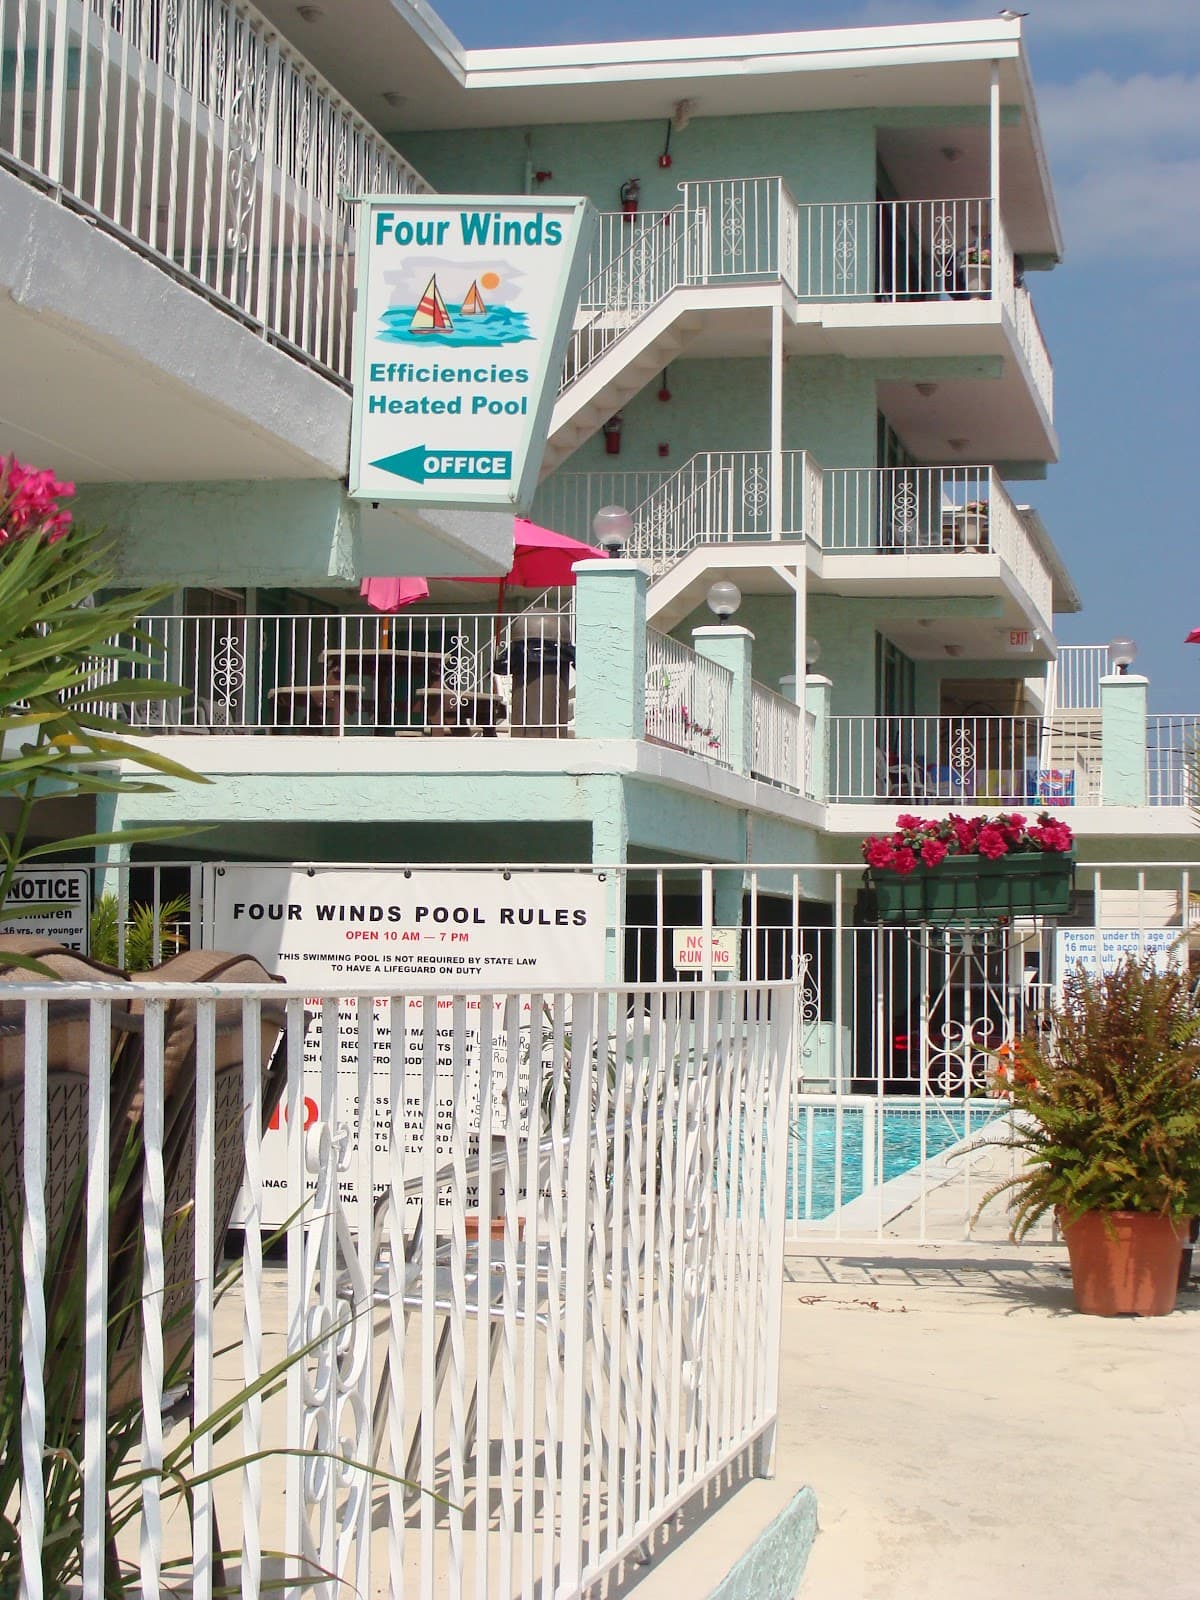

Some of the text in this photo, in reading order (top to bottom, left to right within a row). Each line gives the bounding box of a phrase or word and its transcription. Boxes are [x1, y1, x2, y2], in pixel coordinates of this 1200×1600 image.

[375, 211, 562, 246] Four Winds
[370, 363, 529, 383] Efficiencies
[368, 395, 528, 415] Heated Pool
[423, 455, 507, 474] OFFICE
[1010, 631, 1027, 645] EXIT
[8, 879, 80, 899] NOTICE
[233, 903, 588, 926] FOUR WINDS POOL RULES
[47, 927, 83, 936] younger
[345, 930, 379, 940] OPEN
[383, 931, 398, 941] 10
[401, 932, 420, 941] AM
[439, 932, 447, 941] 7
[451, 933, 469, 942] PM
[1102, 931, 1128, 940] under
[1148, 933, 1164, 942] age
[1066, 943, 1076, 951] 16
[1104, 943, 1114, 951] be
[278, 953, 300, 961] THIS
[303, 953, 351, 962] SWIMMING
[395, 955, 414, 963] NOT
[417, 956, 465, 964] REQUIRED
[469, 957, 481, 965] BY
[517, 958, 537, 966] LAW
[1065, 954, 1075, 964] by
[332, 964, 343, 972] TO
[346, 965, 371, 973] HAVE
[384, 965, 436, 974] LIFEGUARD
[344, 999, 356, 1007] 16
